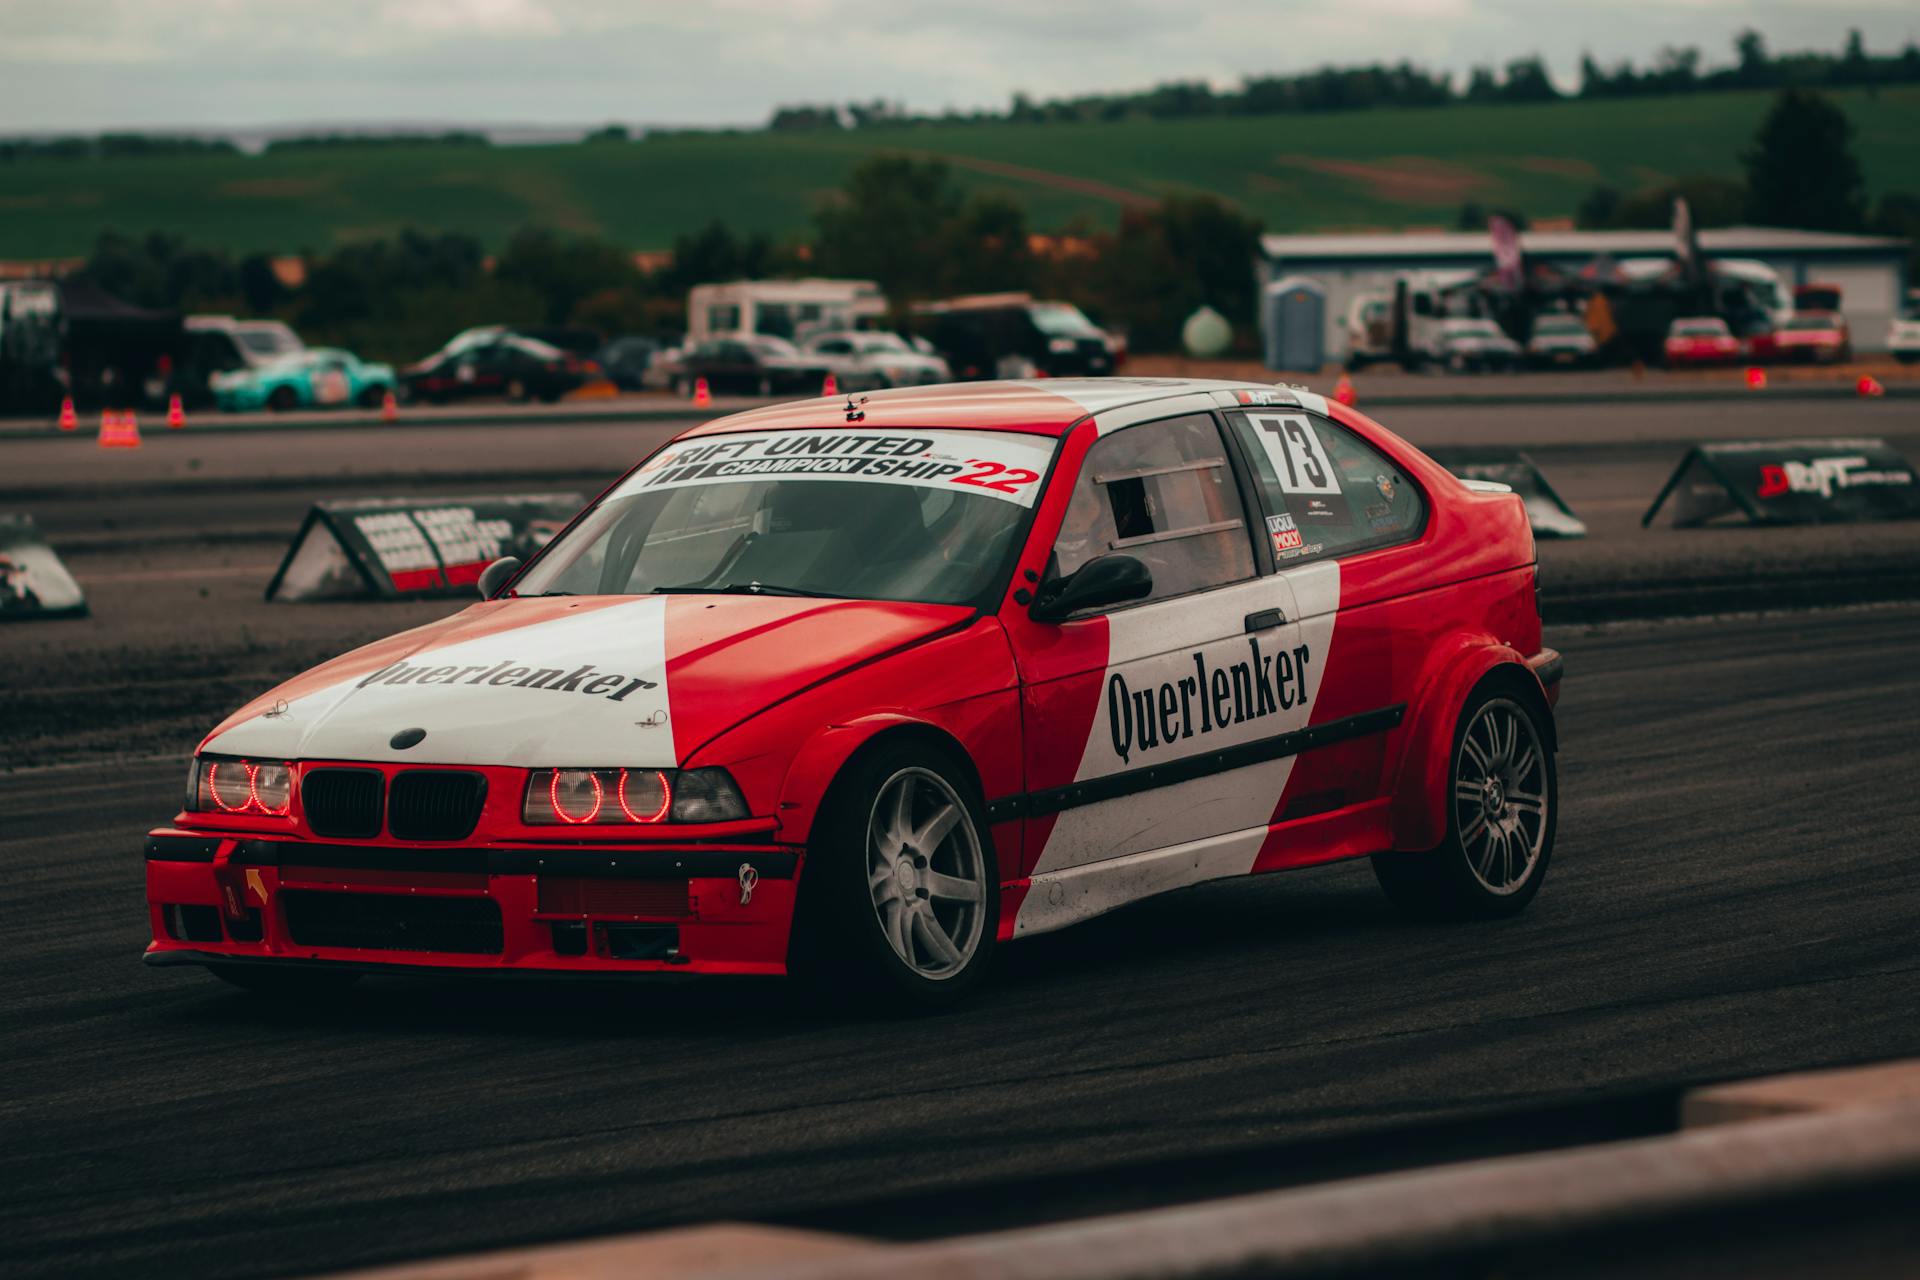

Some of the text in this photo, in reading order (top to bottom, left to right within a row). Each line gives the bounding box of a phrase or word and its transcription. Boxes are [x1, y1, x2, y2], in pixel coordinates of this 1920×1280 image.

[641, 436, 934, 474] DRIFT UNITED
[1259, 420, 1327, 488] 73
[949, 459, 1040, 494] '22
[1268, 515, 1296, 533] LIQUI
[1273, 531, 1300, 548] MOLY
[357, 660, 658, 702] Querlenker
[1108, 637, 1310, 765] Querlenker
